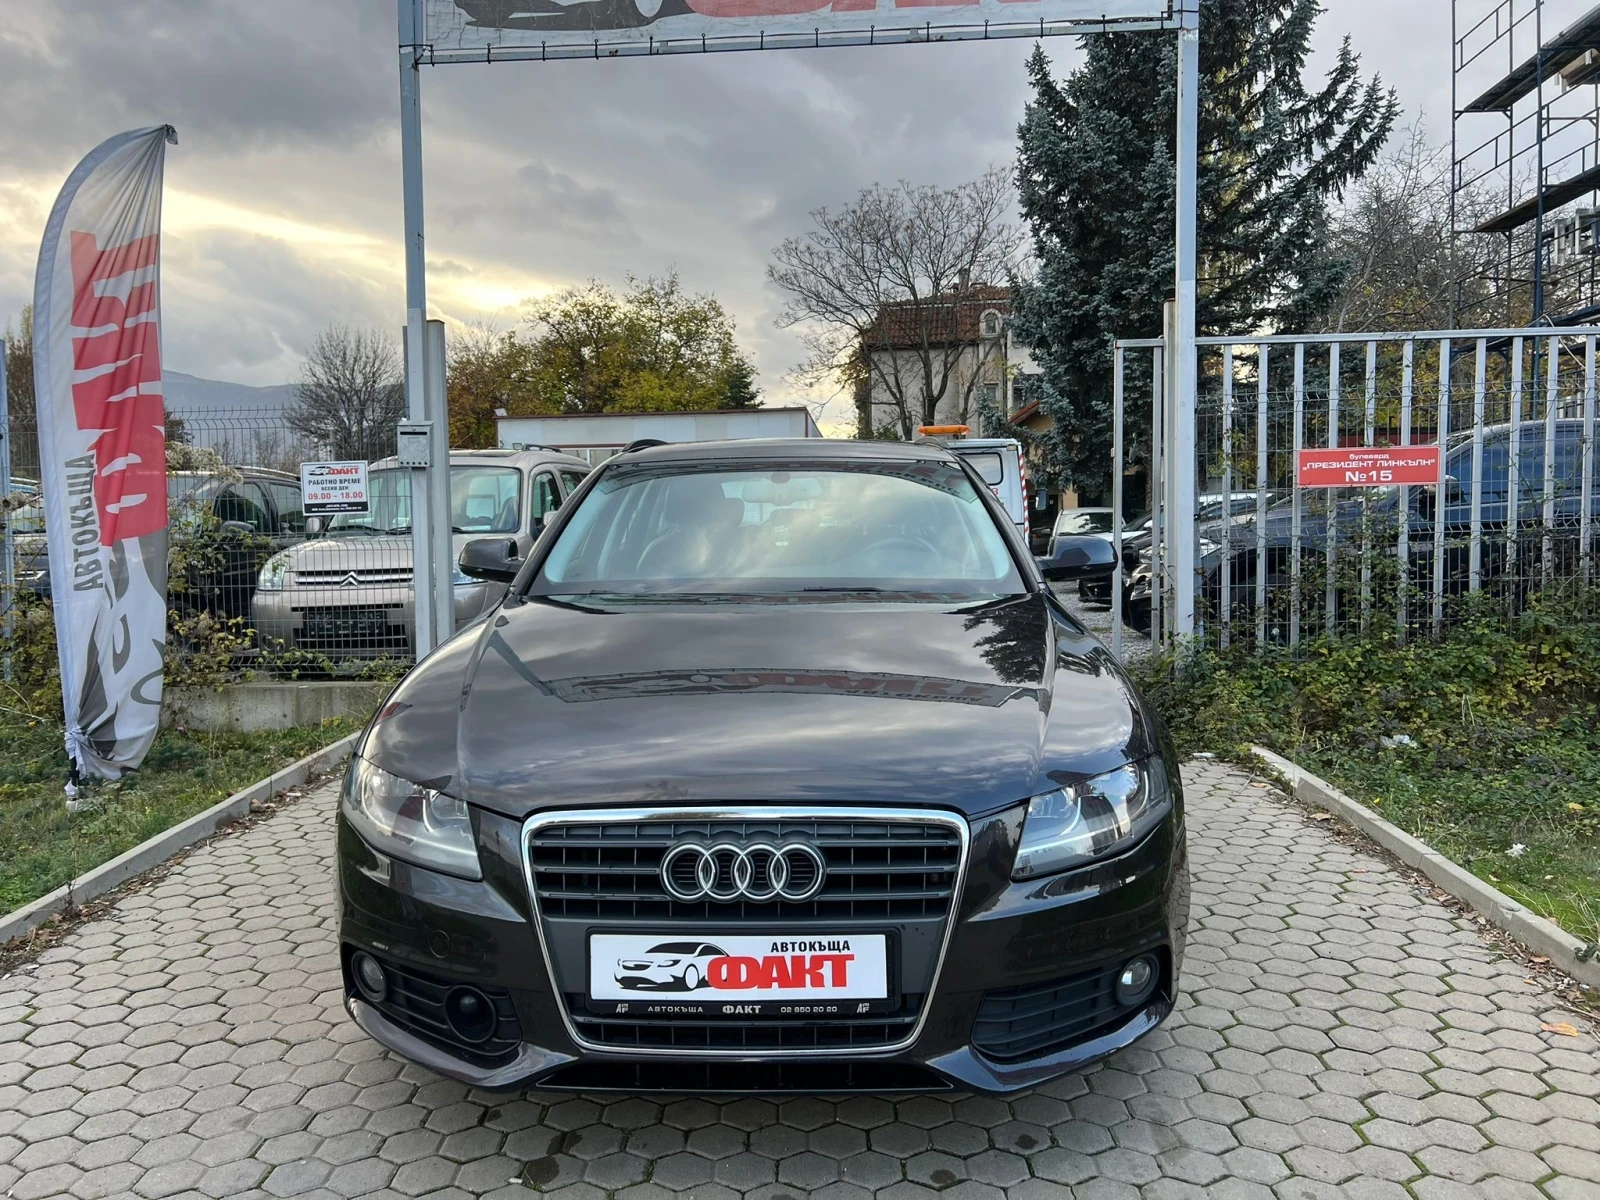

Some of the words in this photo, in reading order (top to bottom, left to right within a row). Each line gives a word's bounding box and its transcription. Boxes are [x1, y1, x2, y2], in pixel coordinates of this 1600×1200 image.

[70, 230, 167, 547] ФАКТ
[308, 492, 332, 500] 09.00
[340, 491, 363, 499] 18.00
[64, 453, 103, 591] АВТОКЪЩА
[771, 940, 851, 953] АВТОКЪЩА
[707, 954, 855, 989] ФАКТ
[722, 1005, 762, 1014] ФАКТ
